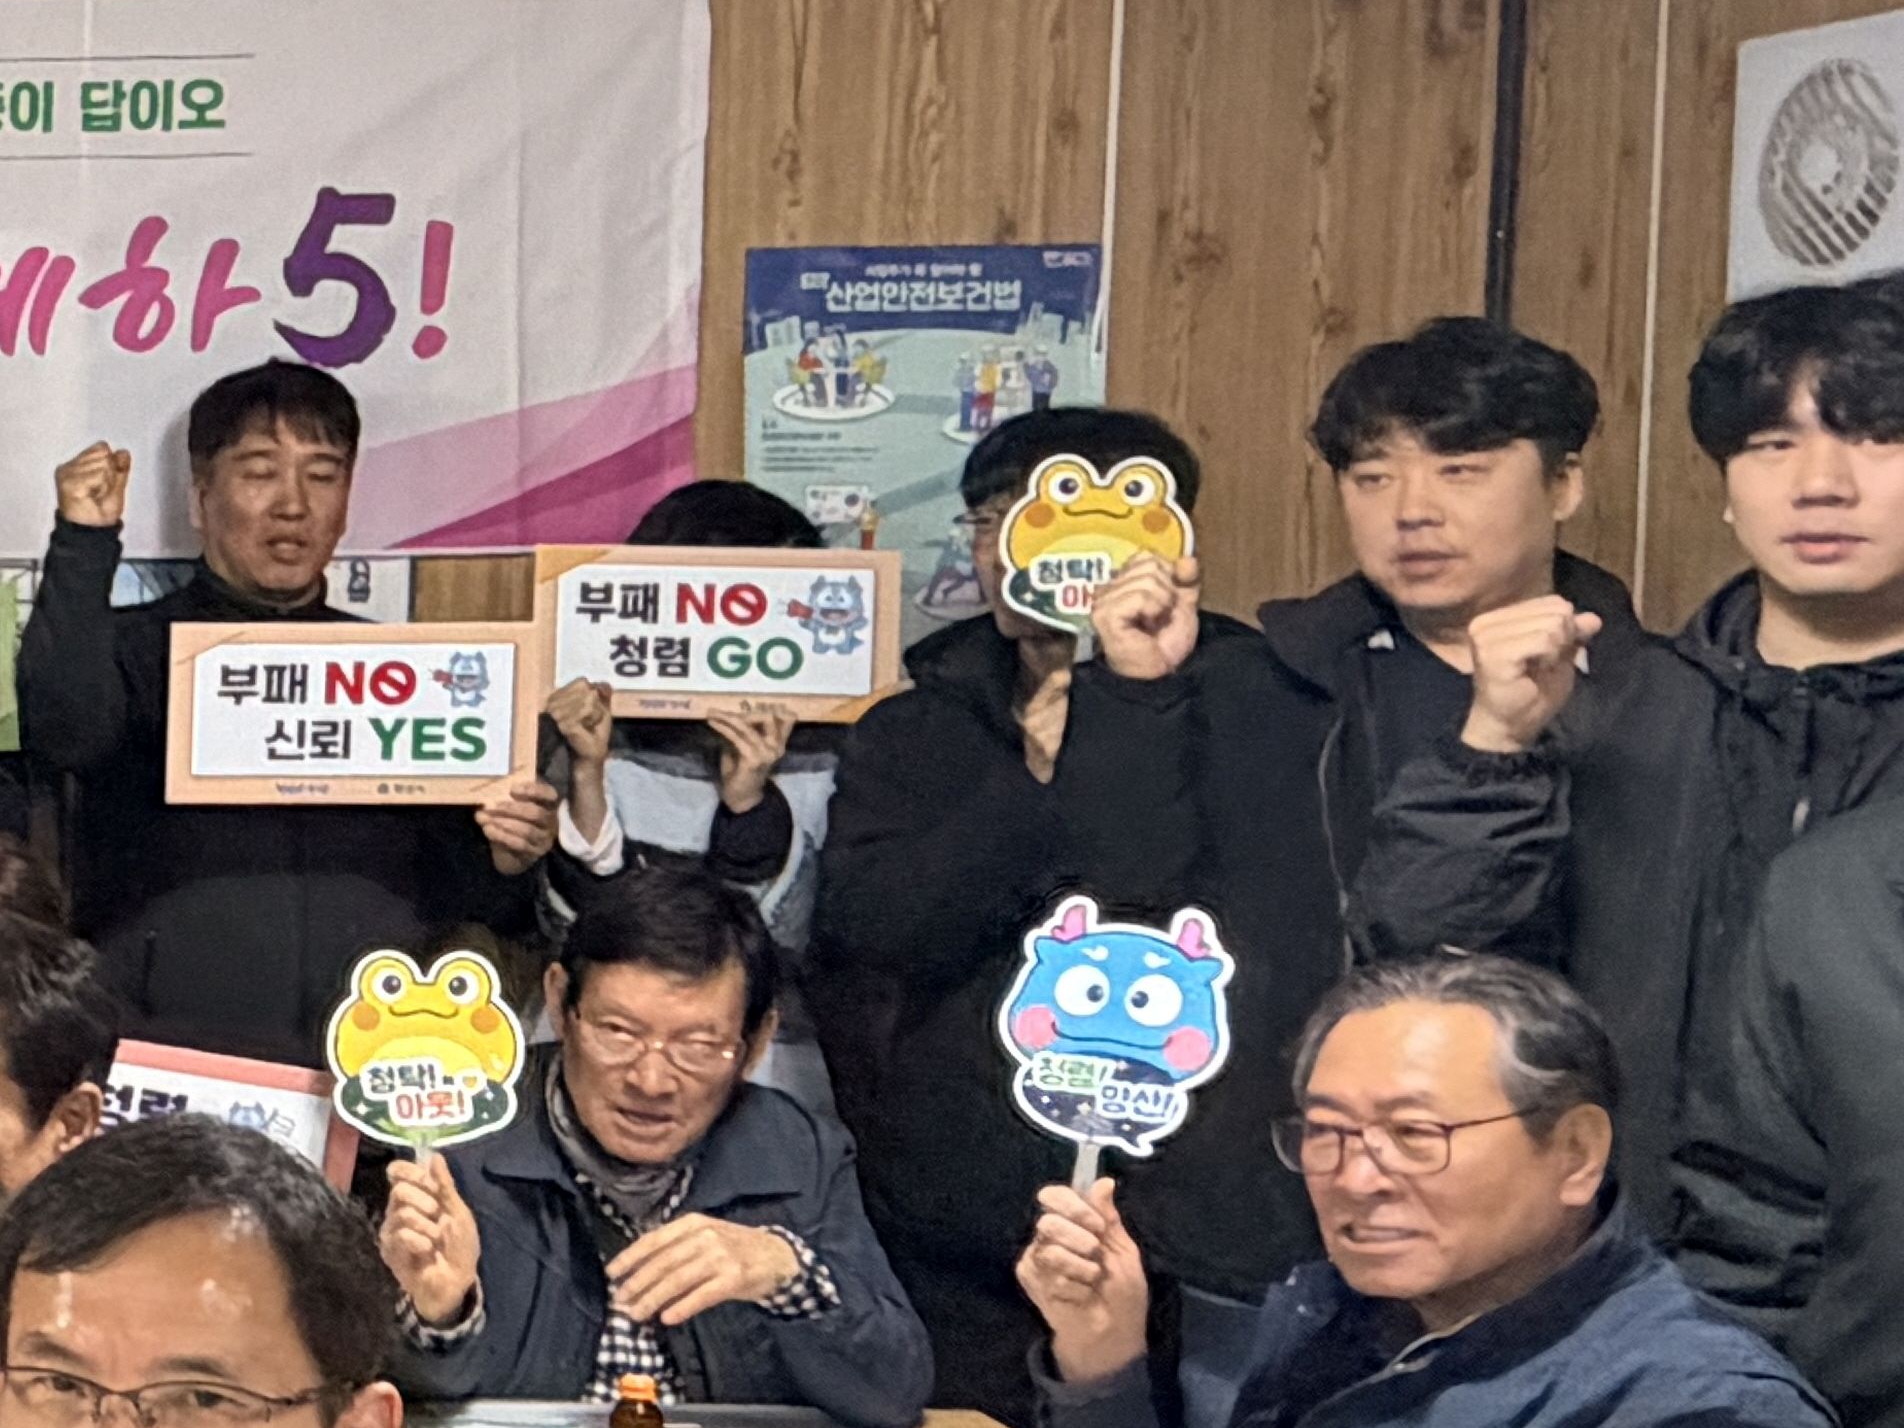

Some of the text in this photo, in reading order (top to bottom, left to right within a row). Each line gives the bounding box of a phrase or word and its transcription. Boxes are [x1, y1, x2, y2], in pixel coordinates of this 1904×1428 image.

[80, 78, 227, 132] 답이오
[826, 279, 1022, 313] 산업안전보건법
[576, 582, 768, 625] 부패 NO
[610, 635, 804, 680] 청렴 GO
[218, 661, 417, 705] 부패 NO
[265, 717, 487, 762] 신뢰 YES
[396, 1090, 465, 1119] 아웃!
